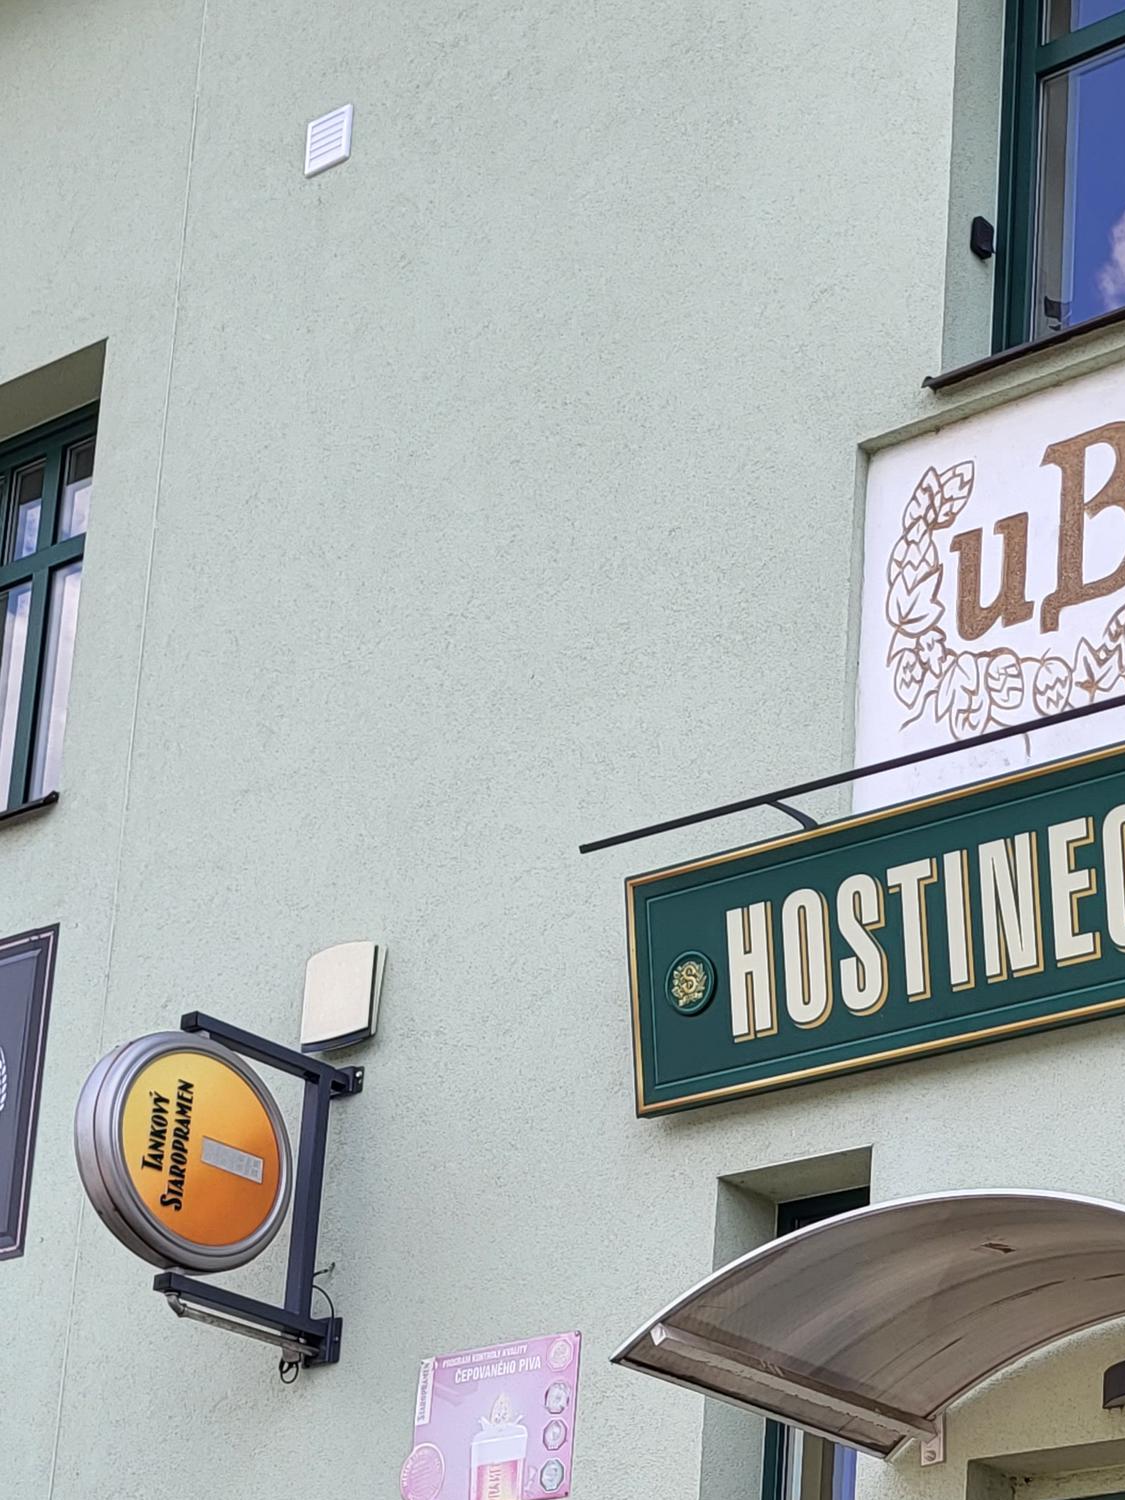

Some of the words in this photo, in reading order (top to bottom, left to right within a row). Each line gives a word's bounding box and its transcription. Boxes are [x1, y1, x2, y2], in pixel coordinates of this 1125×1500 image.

[141, 1090, 171, 1172] TANKOVÝ
[160, 1078, 195, 1212] STAROPRAMEN
[455, 1359, 516, 1384] ČEPOVANÉHO
[519, 1355, 542, 1372] PIVA
